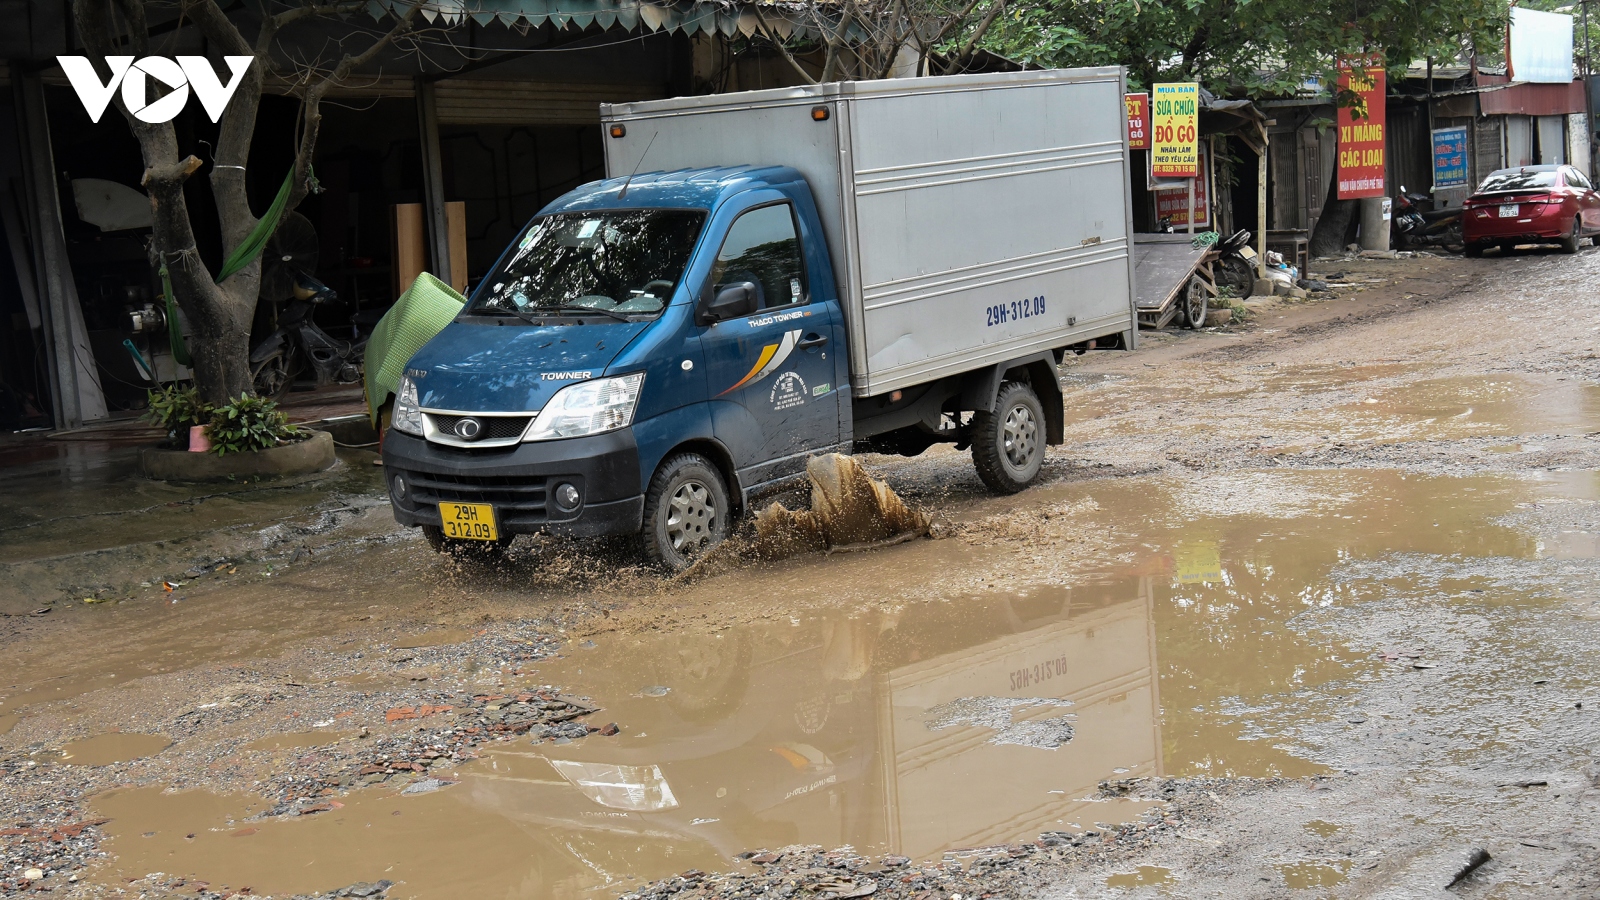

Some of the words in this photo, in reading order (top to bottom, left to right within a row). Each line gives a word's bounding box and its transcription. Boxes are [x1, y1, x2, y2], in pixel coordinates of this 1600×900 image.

[1156, 94, 1172, 115] SỬA
[1174, 97, 1195, 115] CHỮA
[1155, 116, 1174, 143] ĐỒ
[1177, 116, 1195, 143] GỖ
[1341, 126, 1351, 143] XI
[1354, 122, 1382, 142] MĂNG
[1161, 146, 1177, 154] NHẬN
[1340, 147, 1360, 168] CÁC
[1362, 149, 1383, 169] LOẠI
[748, 316, 774, 328] THACO
[773, 311, 804, 323] TOWNER
[986, 295, 1046, 328] 29H-312.09
[540, 371, 592, 381] TOWNER
[454, 505, 479, 521] 29H
[446, 521, 491, 539] 312.09
